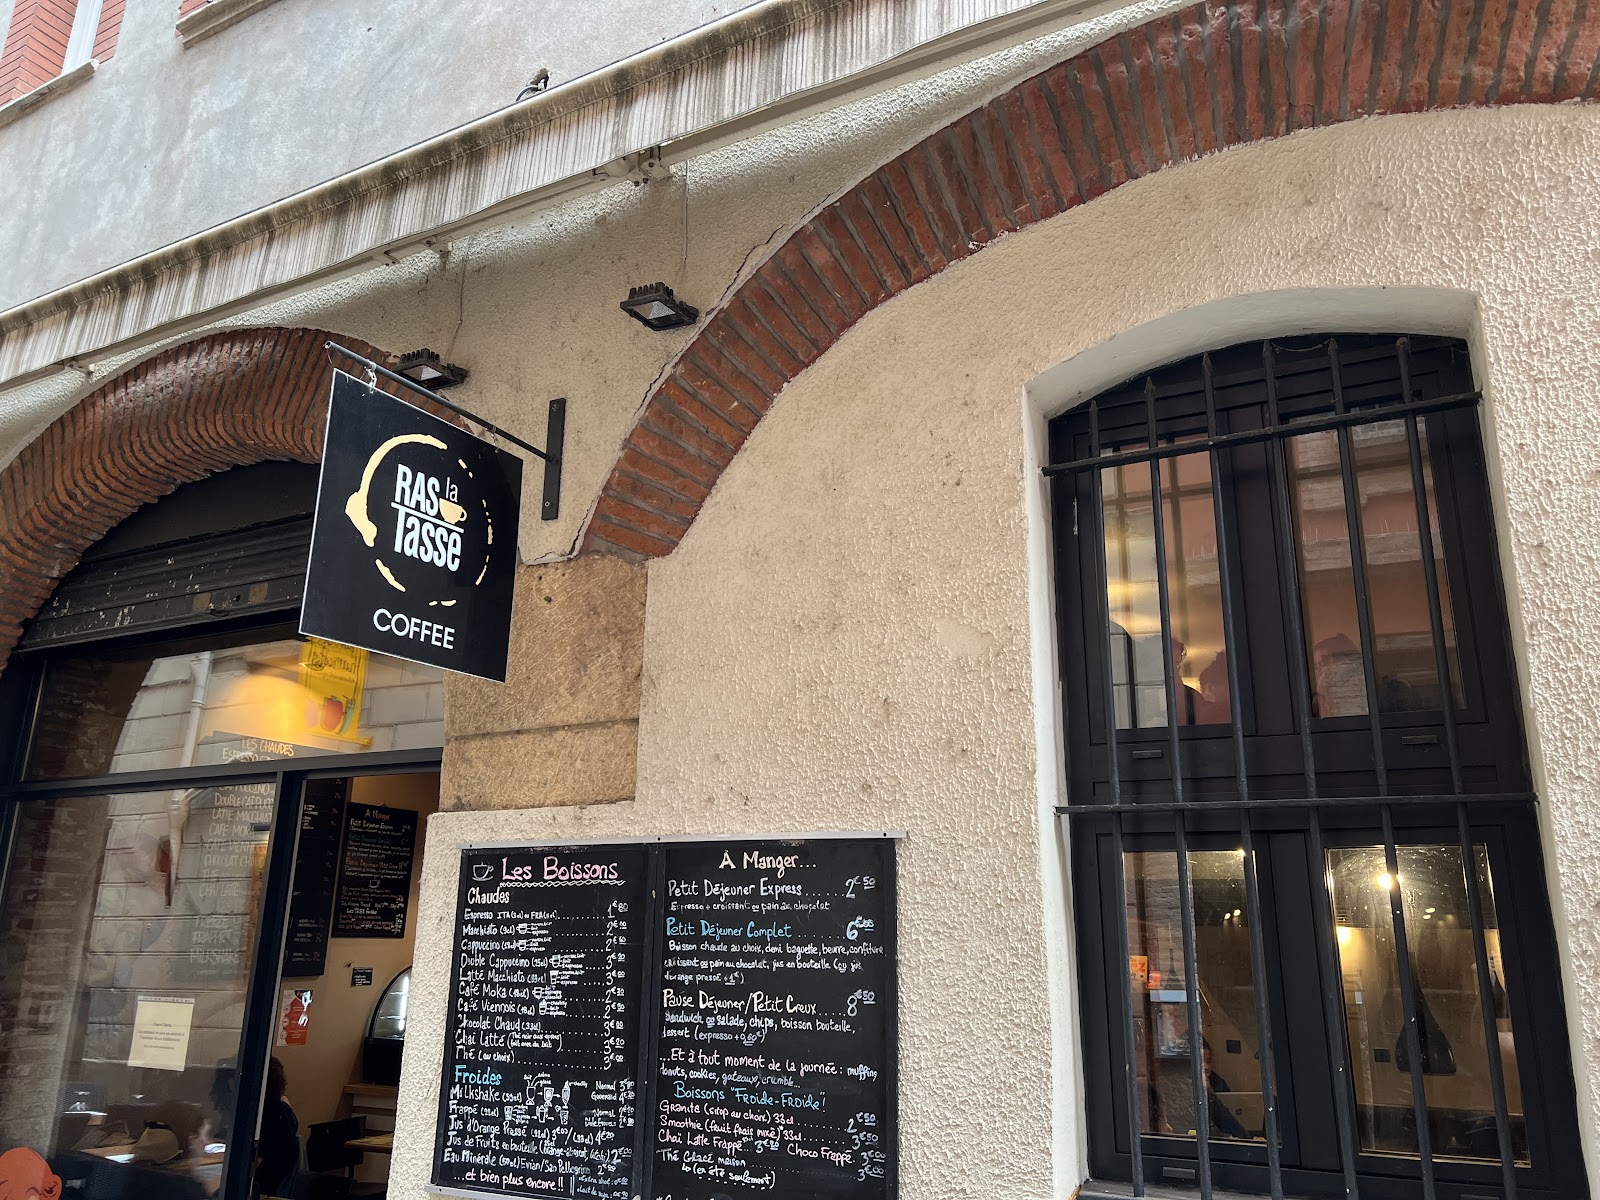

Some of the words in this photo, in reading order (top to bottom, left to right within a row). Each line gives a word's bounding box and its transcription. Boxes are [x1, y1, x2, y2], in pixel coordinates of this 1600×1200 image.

[395, 464, 440, 516] RAS
[446, 476, 459, 502] la
[395, 507, 462, 571] Tasse
[372, 607, 456, 650] COFFEE
[242, 737, 257, 750] LES
[259, 740, 295, 757] CHAUDES
[502, 856, 532, 880] Les
[543, 856, 619, 880] Boissons
[467, 887, 510, 904] Chaudes
[668, 879, 698, 897] Petit
[703, 879, 755, 901] Déjeuner
[759, 877, 802, 901] Express
[464, 908, 493, 922] Espresso
[712, 901, 750, 911] croissant
[761, 902, 779, 915] pain
[793, 900, 831, 915] chocolat
[463, 923, 497, 937] Macchiato
[666, 917, 696, 936] Petit
[700, 920, 743, 941] Déjeuner
[747, 921, 793, 943] Complet
[669, 940, 697, 951] Boisson
[700, 942, 728, 952] chaude
[730, 943, 741, 952] au
[765, 942, 783, 954] demi
[461, 954, 486, 969] Double
[709, 959, 725, 971] pain
[772, 959, 784, 972] jus
[786, 961, 795, 969] en
[796, 958, 831, 970] bouteille
[458, 982, 480, 997] Café
[482, 984, 507, 998] Moka
[457, 998, 479, 1013] Café
[481, 1000, 516, 1015] Viennois
[663, 988, 695, 1008] Pause
[786, 995, 817, 1016] Creux
[494, 1015, 521, 1032] Chaud
[781, 1017, 813, 1031] boisson
[455, 1045, 475, 1060] Thé
[688, 1050, 696, 1063] à
[698, 1049, 721, 1066] tout
[725, 1054, 765, 1069] moment
[768, 1058, 782, 1071] de
[786, 1059, 797, 1072] la
[455, 1065, 502, 1085] Froides
[450, 1086, 500, 1102] Milkshake
[673, 1080, 725, 1100] Boissons
[449, 1101, 478, 1120] Frappé
[730, 1110, 741, 1119] au
[448, 1115, 464, 1131] Jus
[659, 1115, 703, 1131] Smoothie
[734, 1123, 754, 1139] frais
[447, 1132, 462, 1147] Jus
[464, 1136, 474, 1148] de
[475, 1135, 499, 1151] Fruits
[444, 1148, 460, 1163] Eau
[461, 1150, 497, 1167] Minérale
[655, 1148, 679, 1161] Thé
[718, 1156, 746, 1167] maison
[787, 1144, 818, 1158] Choco
[821, 1148, 853, 1167] Frappé
[480, 1170, 500, 1185] bien
[502, 1174, 523, 1192] plus
[709, 1165, 725, 1178] été
